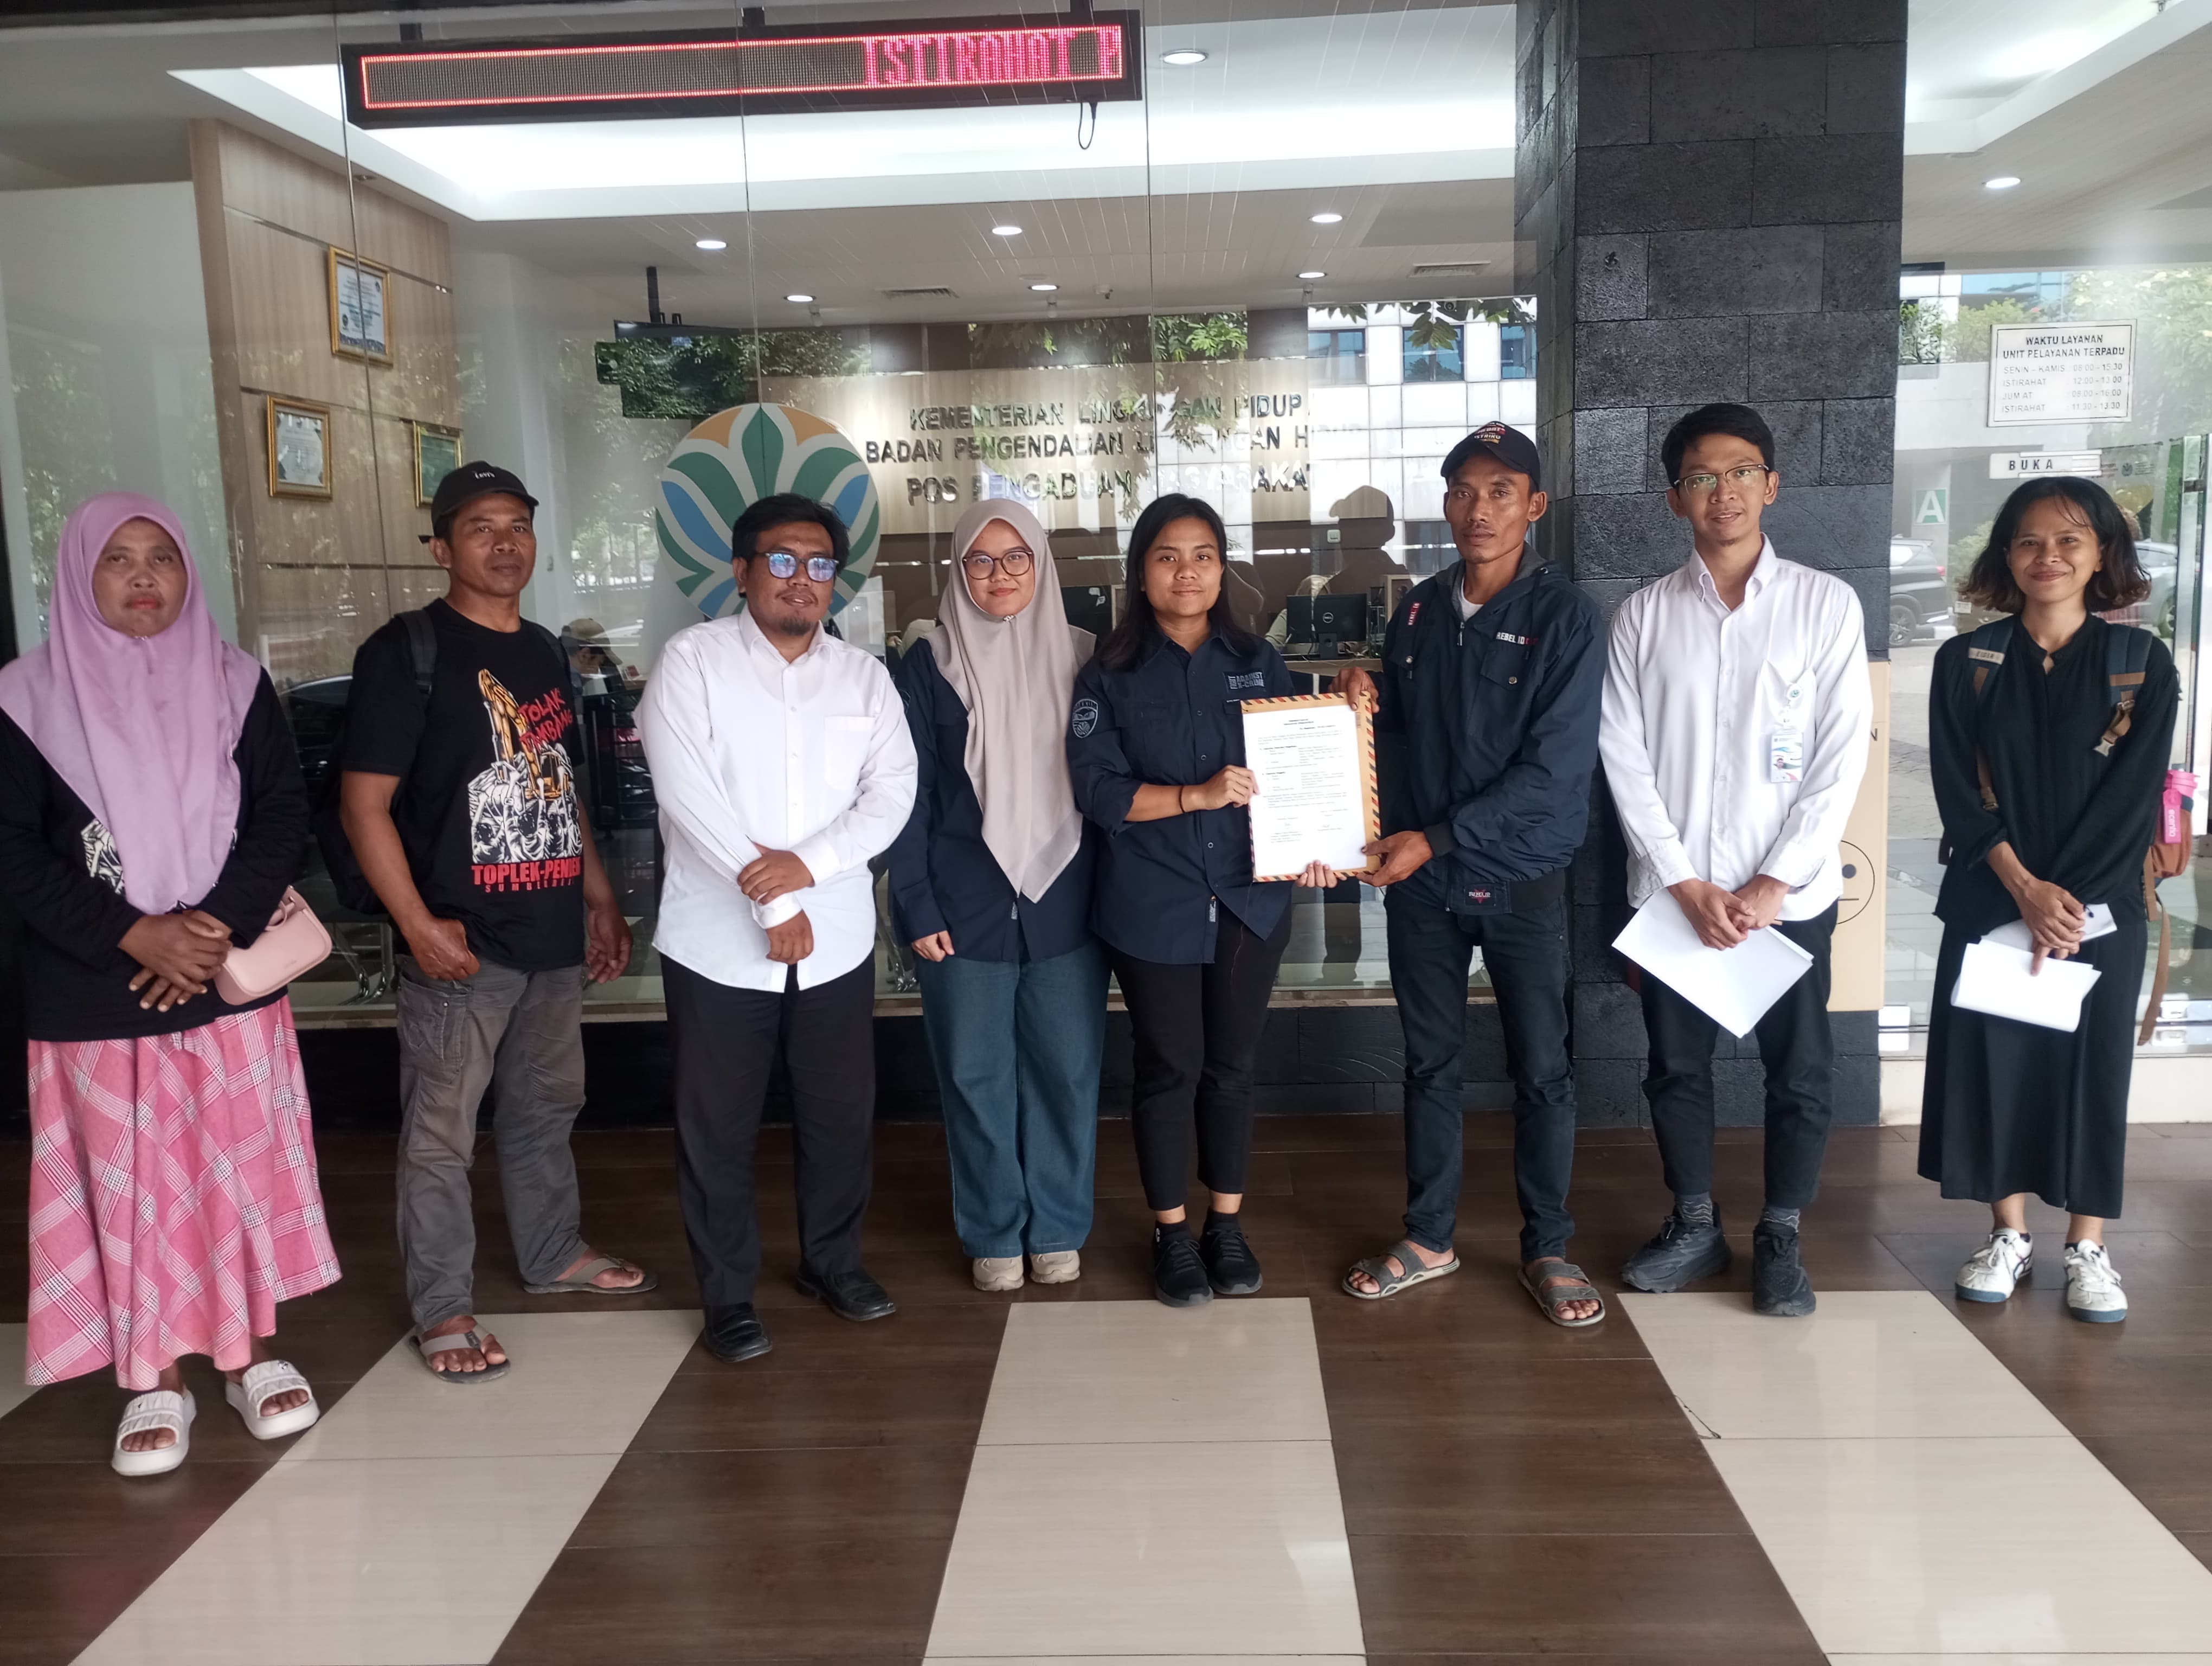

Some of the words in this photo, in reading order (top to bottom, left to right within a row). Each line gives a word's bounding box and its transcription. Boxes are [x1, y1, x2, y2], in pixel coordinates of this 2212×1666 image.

[865, 31, 1077, 85] ISTIRAHAT
[2026, 336, 2059, 345] WAKTU
[2061, 335, 2104, 344] LAYANAN
[2003, 350, 2024, 359] UNIT
[2028, 348, 2081, 358] PELAYANAN
[2084, 347, 2125, 356] TERPADU
[2003, 366, 2029, 374] SENIN
[2039, 364, 2065, 373] KAMIS
[2102, 363, 2123, 371] 15.30
[2003, 378, 2047, 387] ISTIRAHAT
[2002, 403, 2046, 413] ISTIRAHAT
[910, 402, 1064, 431] KEMENTERIAN
[866, 438, 943, 463] BADAN
[954, 431, 1124, 460] PENGENDALIAN
[2009, 459, 2053, 471] BUKA
[906, 475, 959, 506] POS
[1917, 490, 1945, 523] A
[1496, 632, 1516, 643] REBEL
[518, 688, 565, 724] TOLAK
